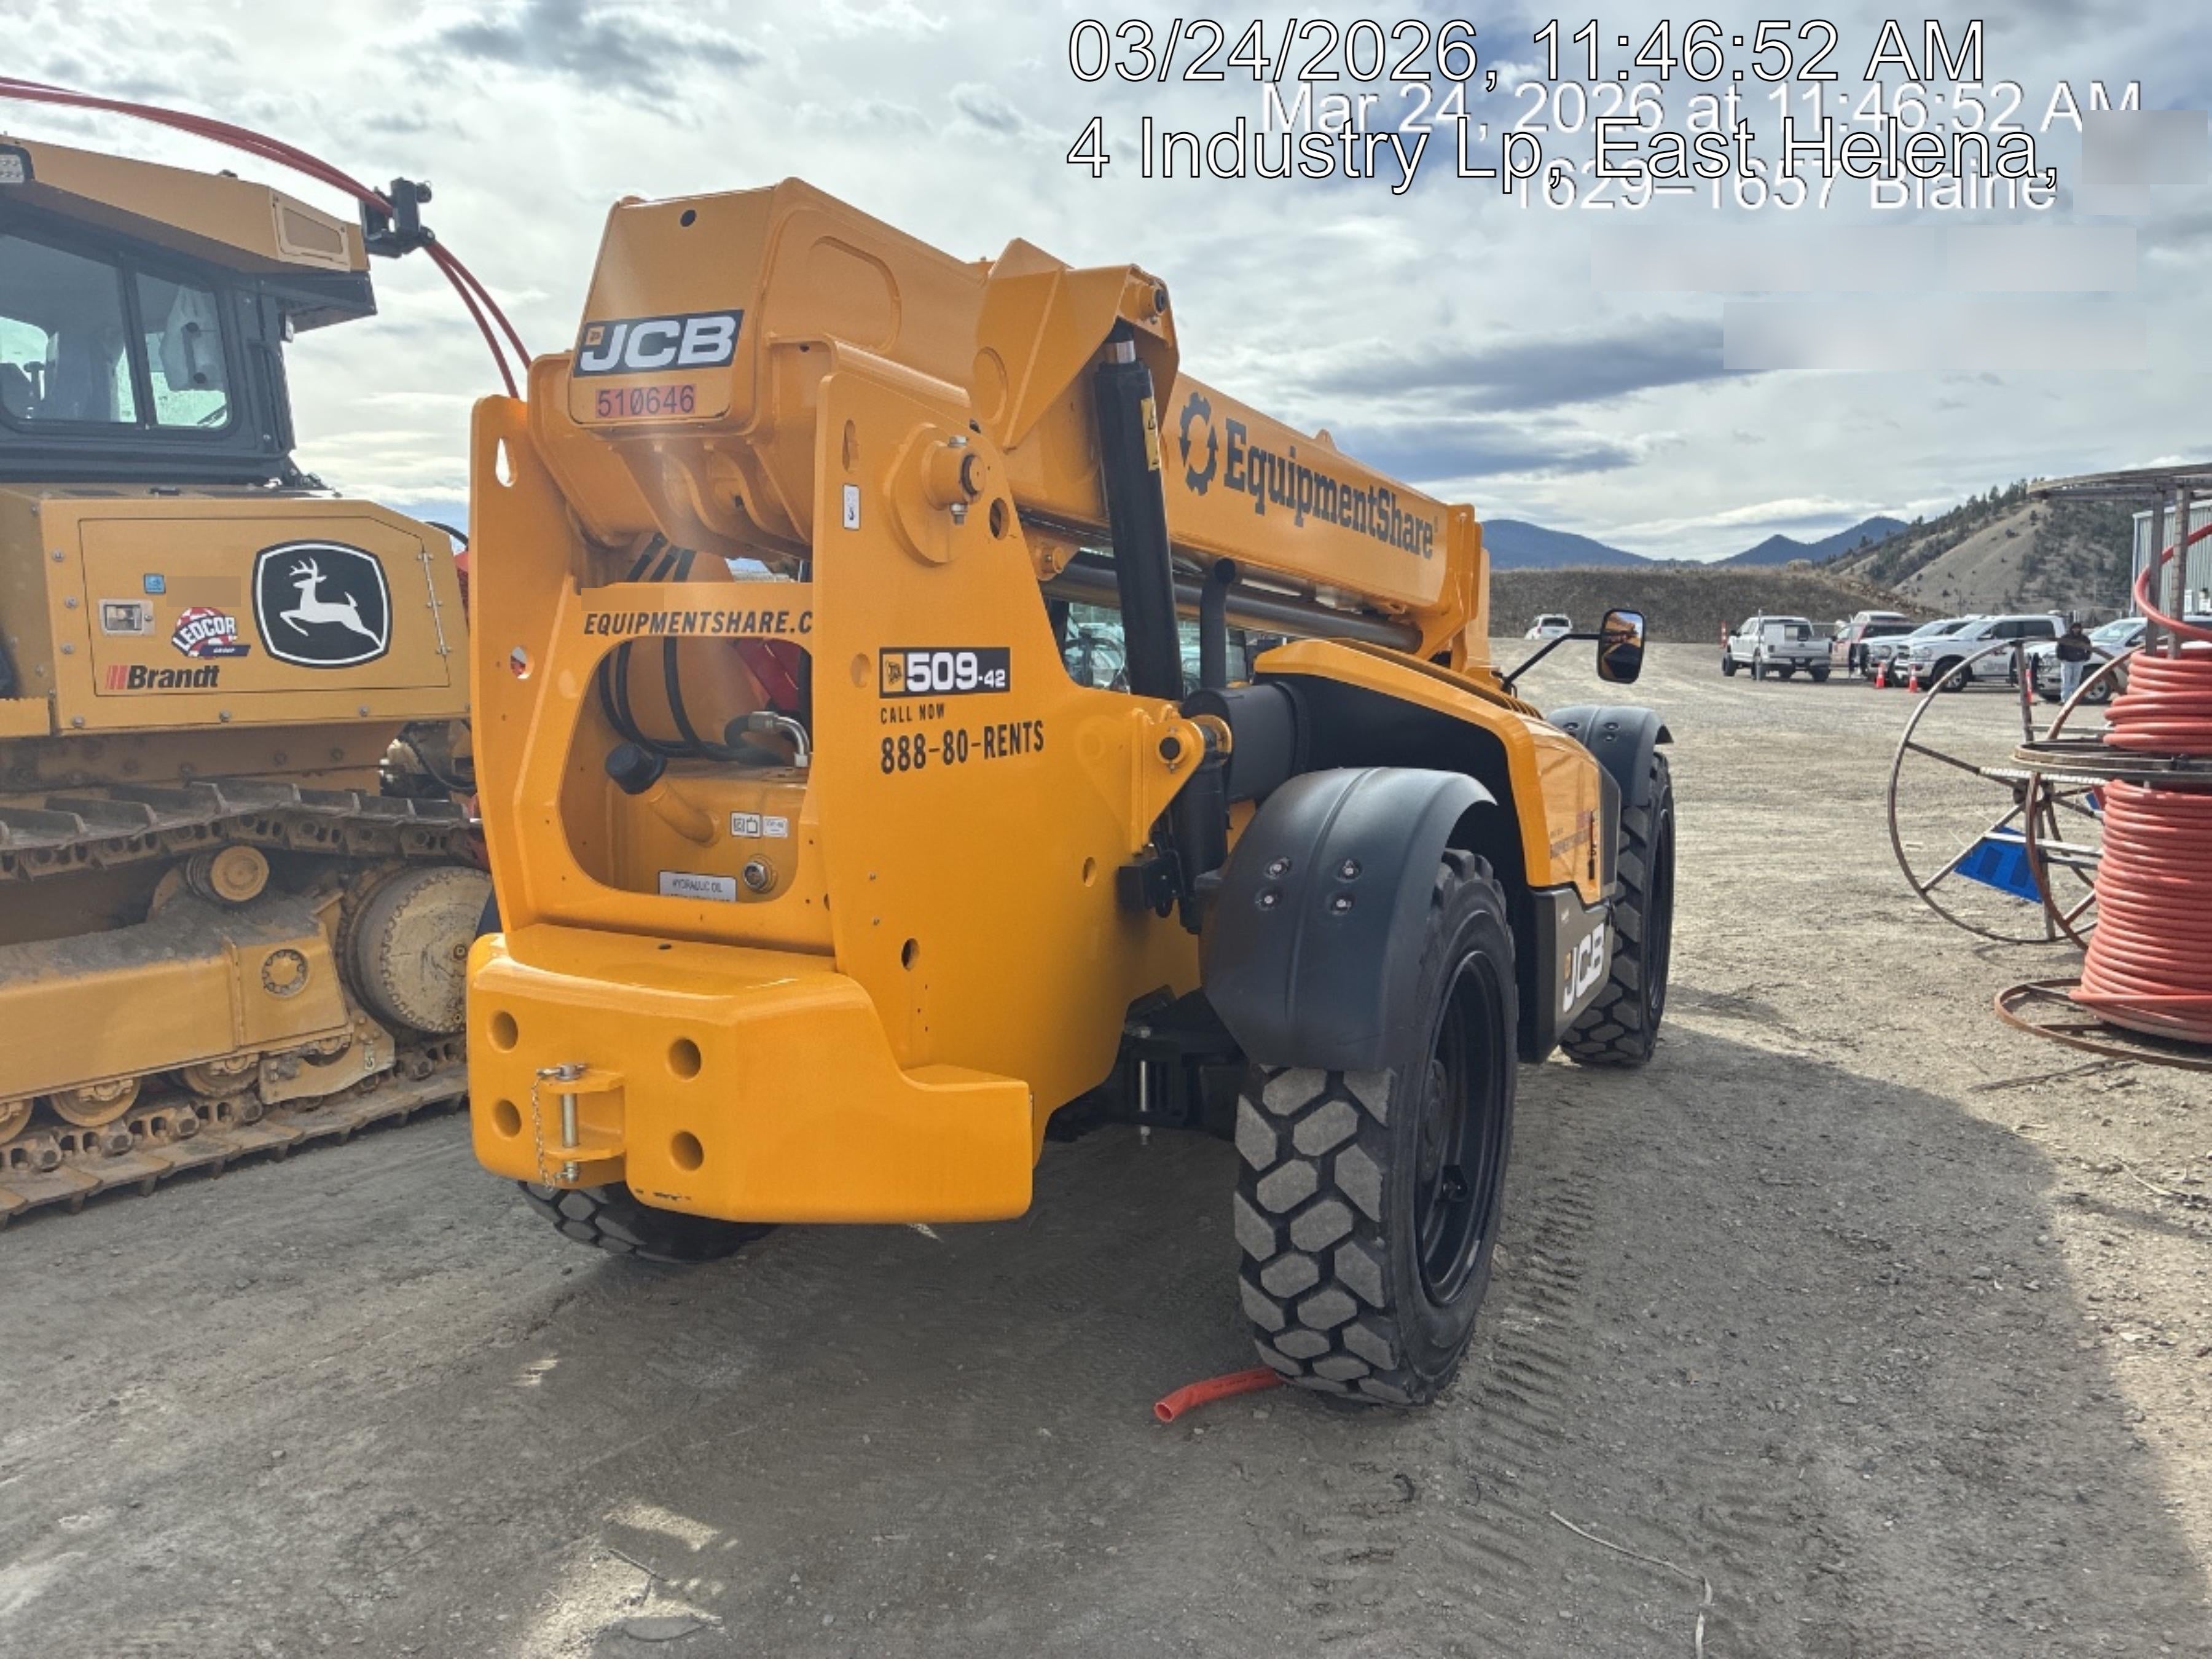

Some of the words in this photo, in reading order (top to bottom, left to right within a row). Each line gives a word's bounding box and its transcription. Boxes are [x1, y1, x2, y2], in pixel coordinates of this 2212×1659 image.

[580, 316, 737, 371] JCB
[597, 385, 695, 418] 510646
[1224, 418, 1433, 560] EquipmentShare
[172, 616, 236, 652] LEDCOR
[127, 665, 219, 689] Brandt
[880, 706, 912, 724] CALL
[919, 703, 944, 721] NOW
[881, 720, 1044, 775] 888-80-RENTS
[1563, 922, 1605, 1013] JCB
